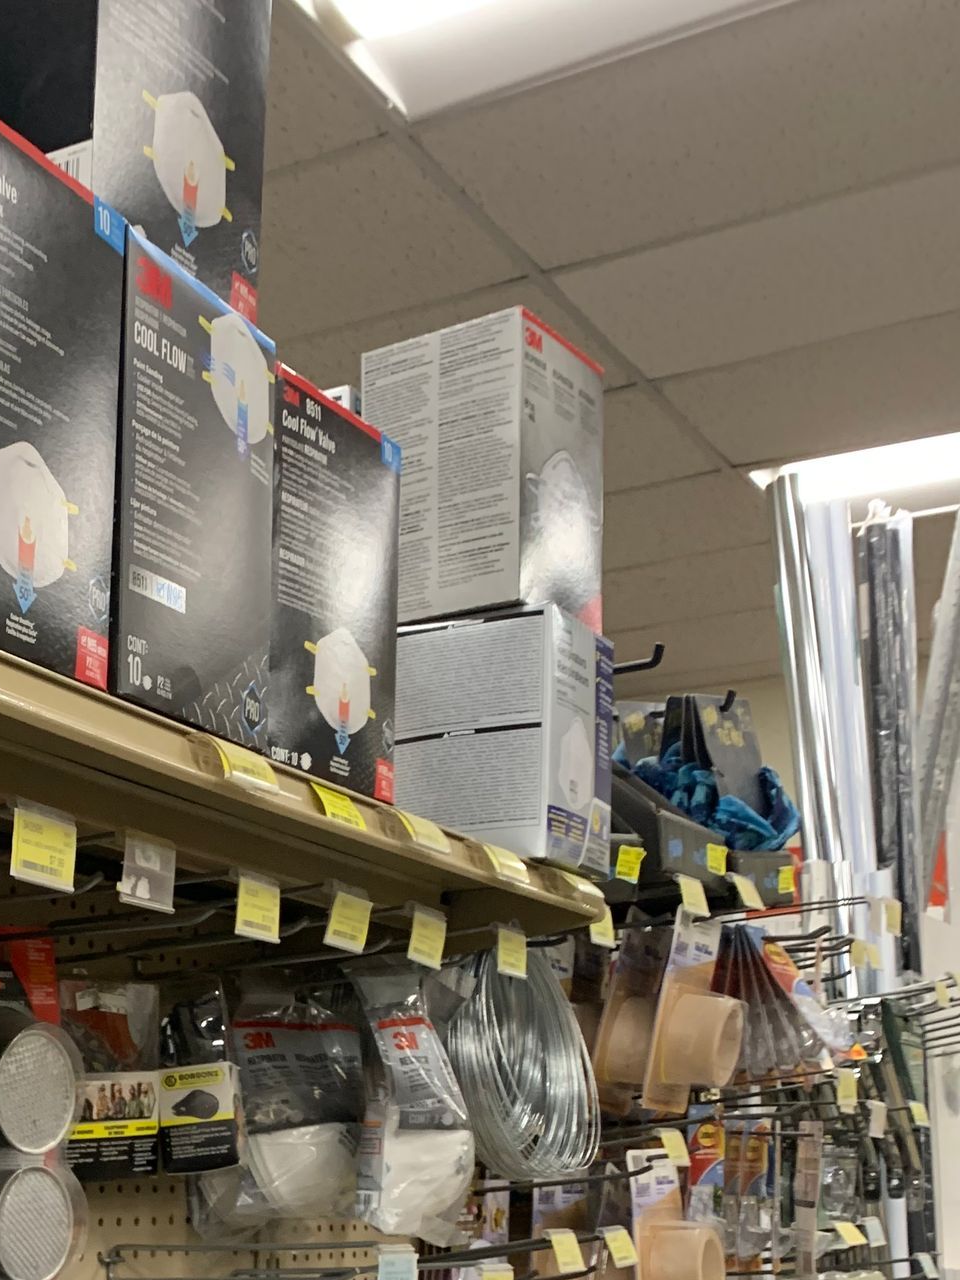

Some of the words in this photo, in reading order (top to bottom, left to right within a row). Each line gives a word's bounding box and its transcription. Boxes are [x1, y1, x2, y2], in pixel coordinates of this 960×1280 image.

[97, 206, 111, 236] 10
[136, 256, 172, 311] 3M
[134, 321, 160, 357] COOL
[161, 338, 187, 374] FLOW
[305, 398, 322, 422] 8511
[282, 409, 299, 432] Cool
[318, 428, 336, 454] Valve
[90, 588, 107, 614] PRO
[127, 635, 149, 655] CONT:
[127, 653, 141, 686] 10
[245, 697, 260, 723] PRO
[271, 746, 290, 764] CONT:
[244, 1031, 276, 1050] 3M
